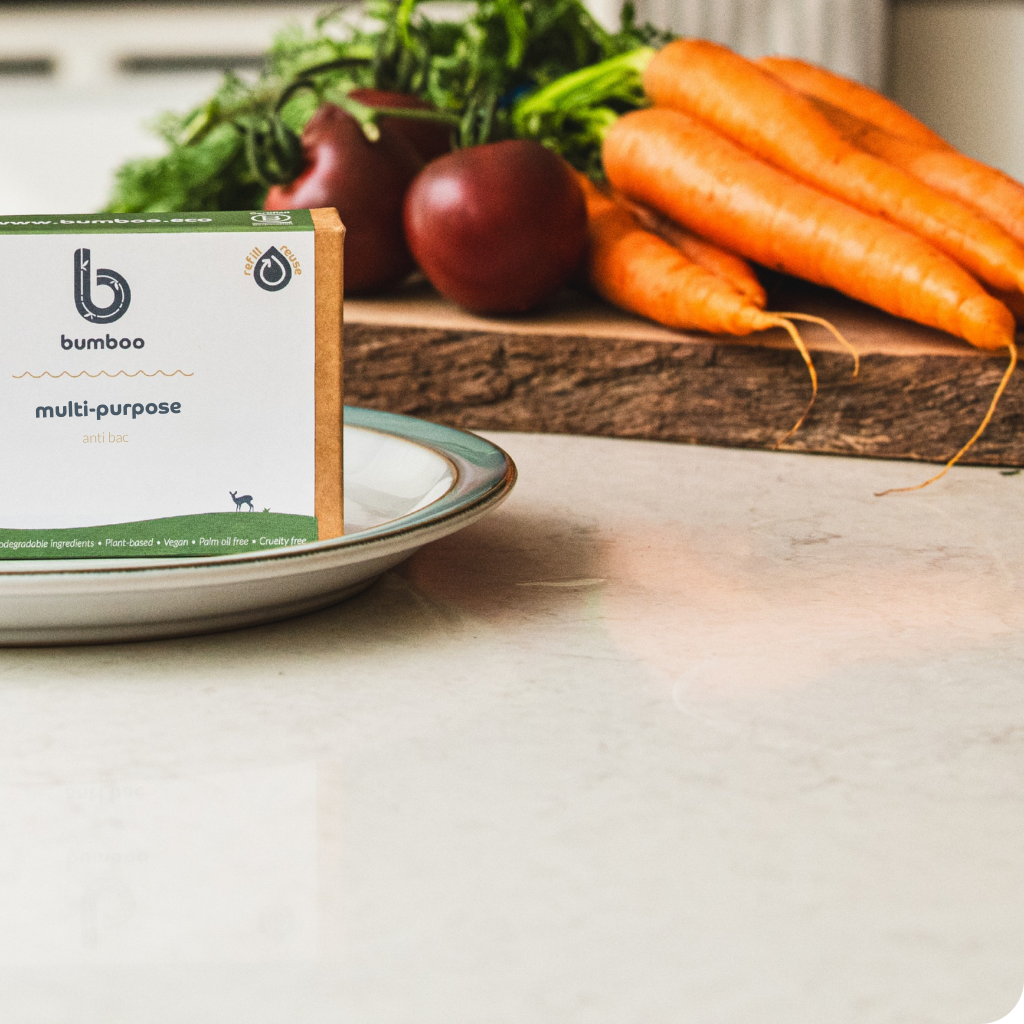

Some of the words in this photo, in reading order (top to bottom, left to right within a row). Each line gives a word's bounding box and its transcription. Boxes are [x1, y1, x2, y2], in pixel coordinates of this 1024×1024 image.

[244, 247, 262, 276] refill
[280, 246, 302, 274] reuse
[61, 334, 144, 350] bumboo
[35, 400, 182, 420] multi-purpose
[83, 432, 104, 443] anti
[108, 432, 129, 443] bac
[51, 539, 94, 549] ingredients
[105, 538, 154, 547] Plant-based
[164, 538, 189, 548] Vegan
[199, 537, 220, 546] Palm
[220, 537, 232, 546] oil
[233, 537, 249, 546] free
[259, 536, 289, 546] Cruelty
[290, 536, 307, 545] free
